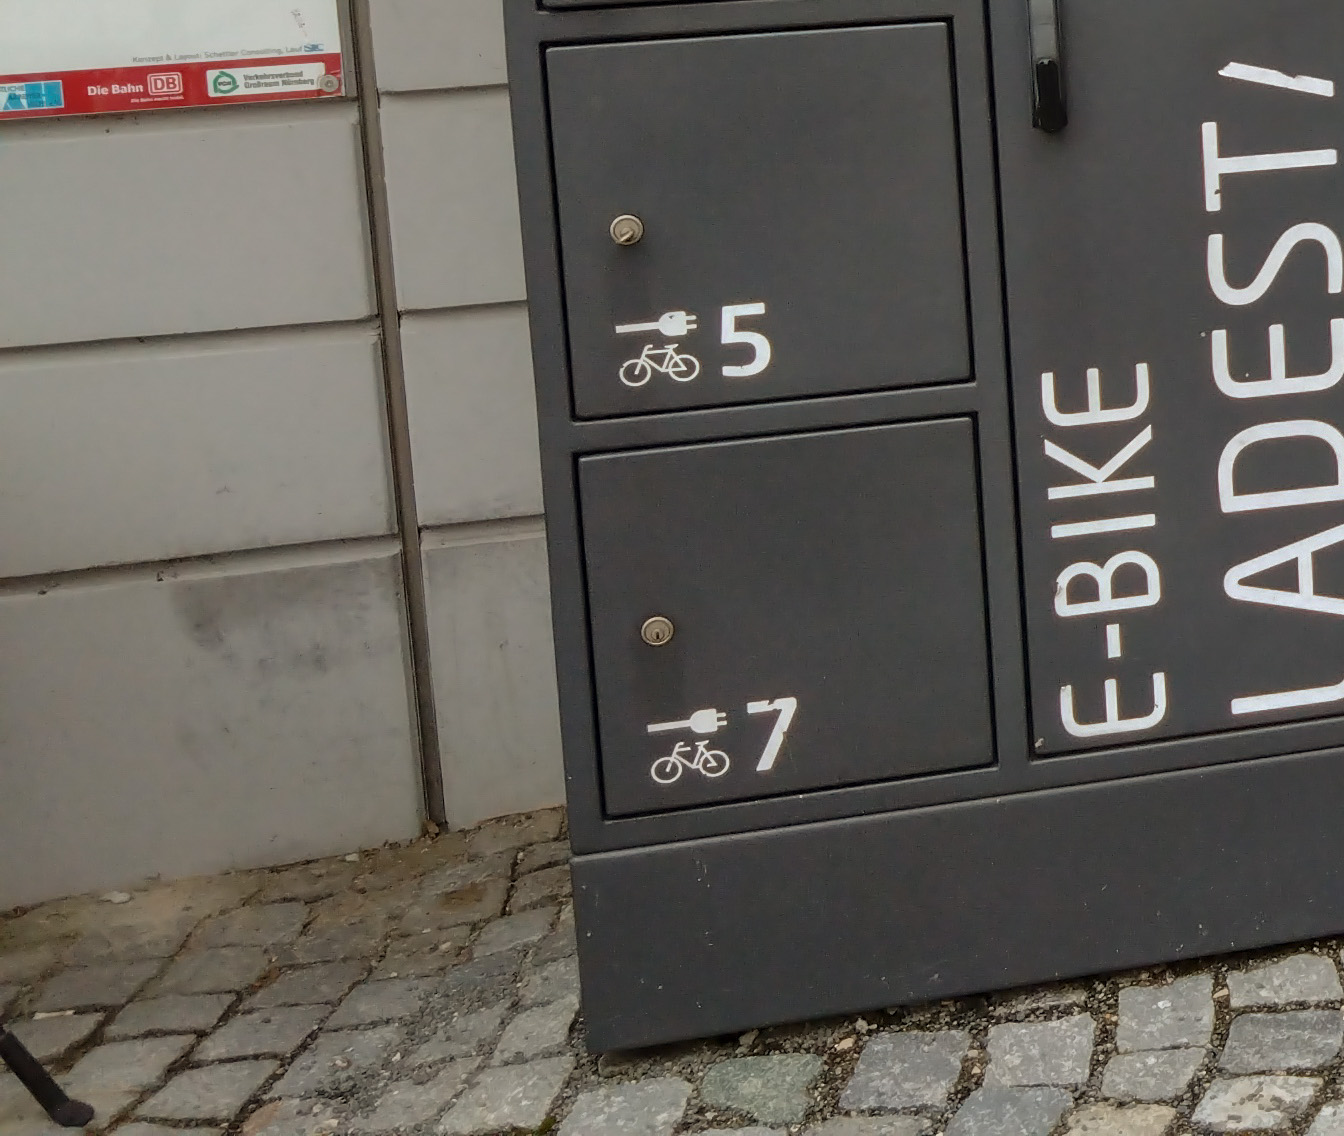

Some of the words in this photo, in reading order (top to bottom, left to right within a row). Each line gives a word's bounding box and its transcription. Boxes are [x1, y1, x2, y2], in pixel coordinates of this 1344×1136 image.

[87, 84, 109, 96] Die
[111, 83, 144, 95] Bahn
[153, 75, 178, 91] DB
[721, 302, 772, 378] 5
[1041, 362, 1167, 738] E-BIKE
[746, 697, 798, 772] 7
